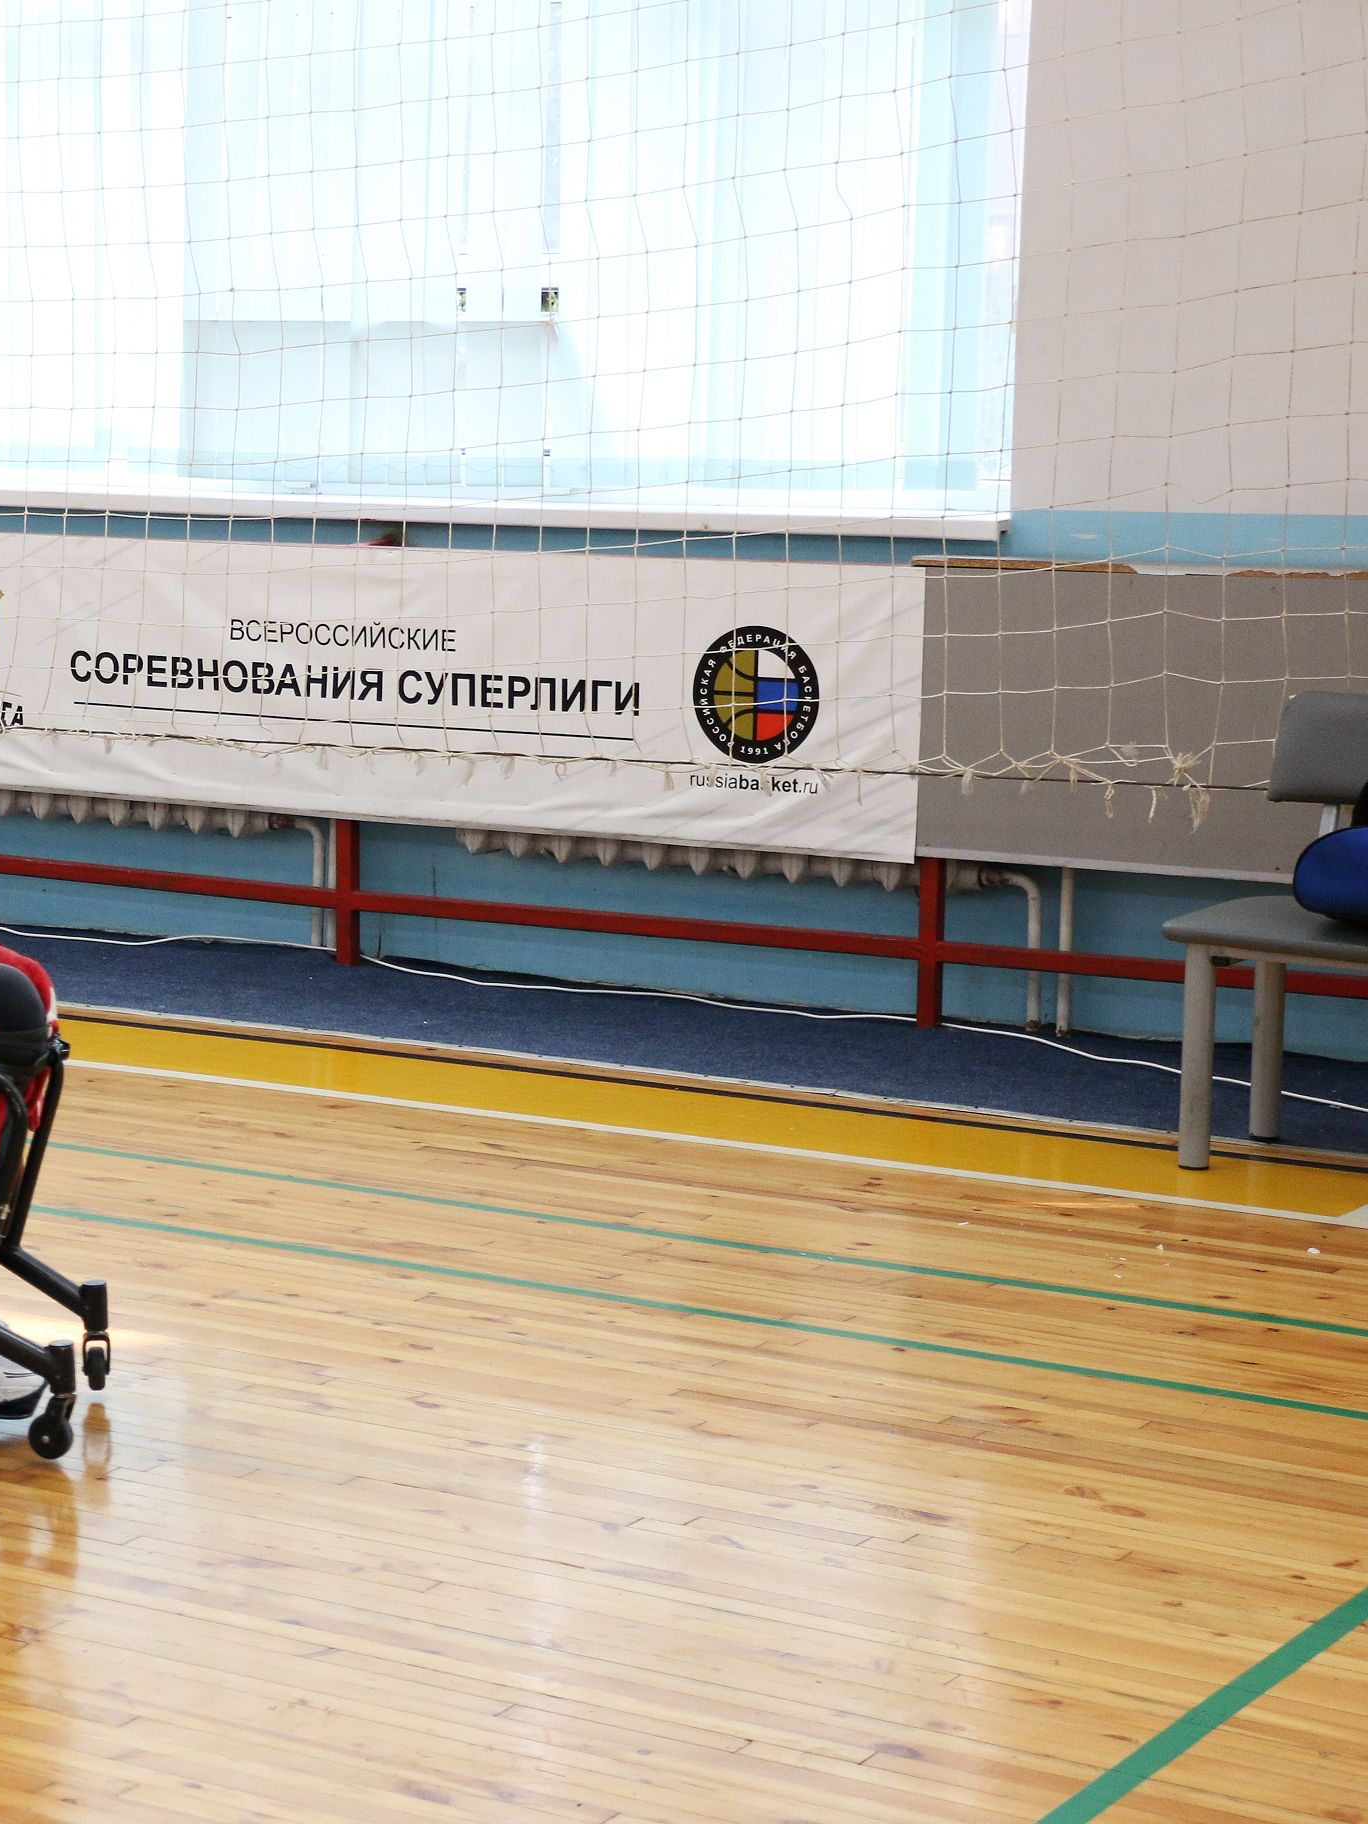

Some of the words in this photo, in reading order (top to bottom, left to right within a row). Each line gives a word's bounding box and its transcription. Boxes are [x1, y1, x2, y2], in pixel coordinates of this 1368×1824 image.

[229, 619, 457, 652] ВСЕРОССИЙСКИЕ
[70, 650, 384, 702] СОРЕВНОВАНИЯ
[398, 670, 640, 716] СУПЕРЛИГИ
[699, 658, 735, 748] РОССИЙСКАЯ
[739, 745, 769, 755] 1991
[689, 772, 819, 796] rusiabaket.ru
